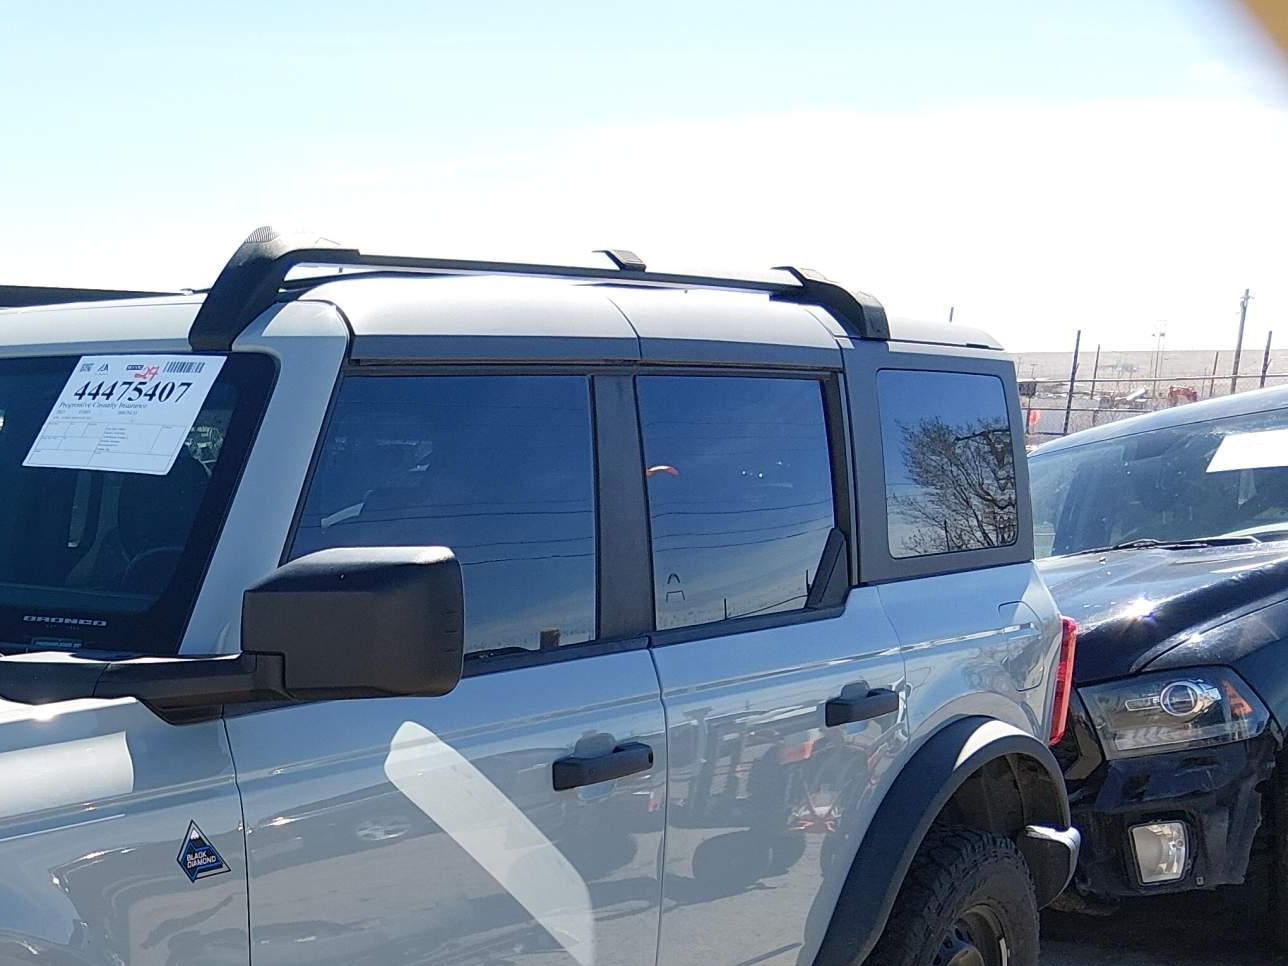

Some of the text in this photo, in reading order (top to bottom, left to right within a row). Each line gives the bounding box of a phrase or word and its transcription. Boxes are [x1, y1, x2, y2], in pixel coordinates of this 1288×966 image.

[73, 380, 193, 403] 44475407
[23, 615, 107, 627] BRONCO
[186, 850, 207, 861] BLACK
[187, 855, 217, 869] DIAMOND
